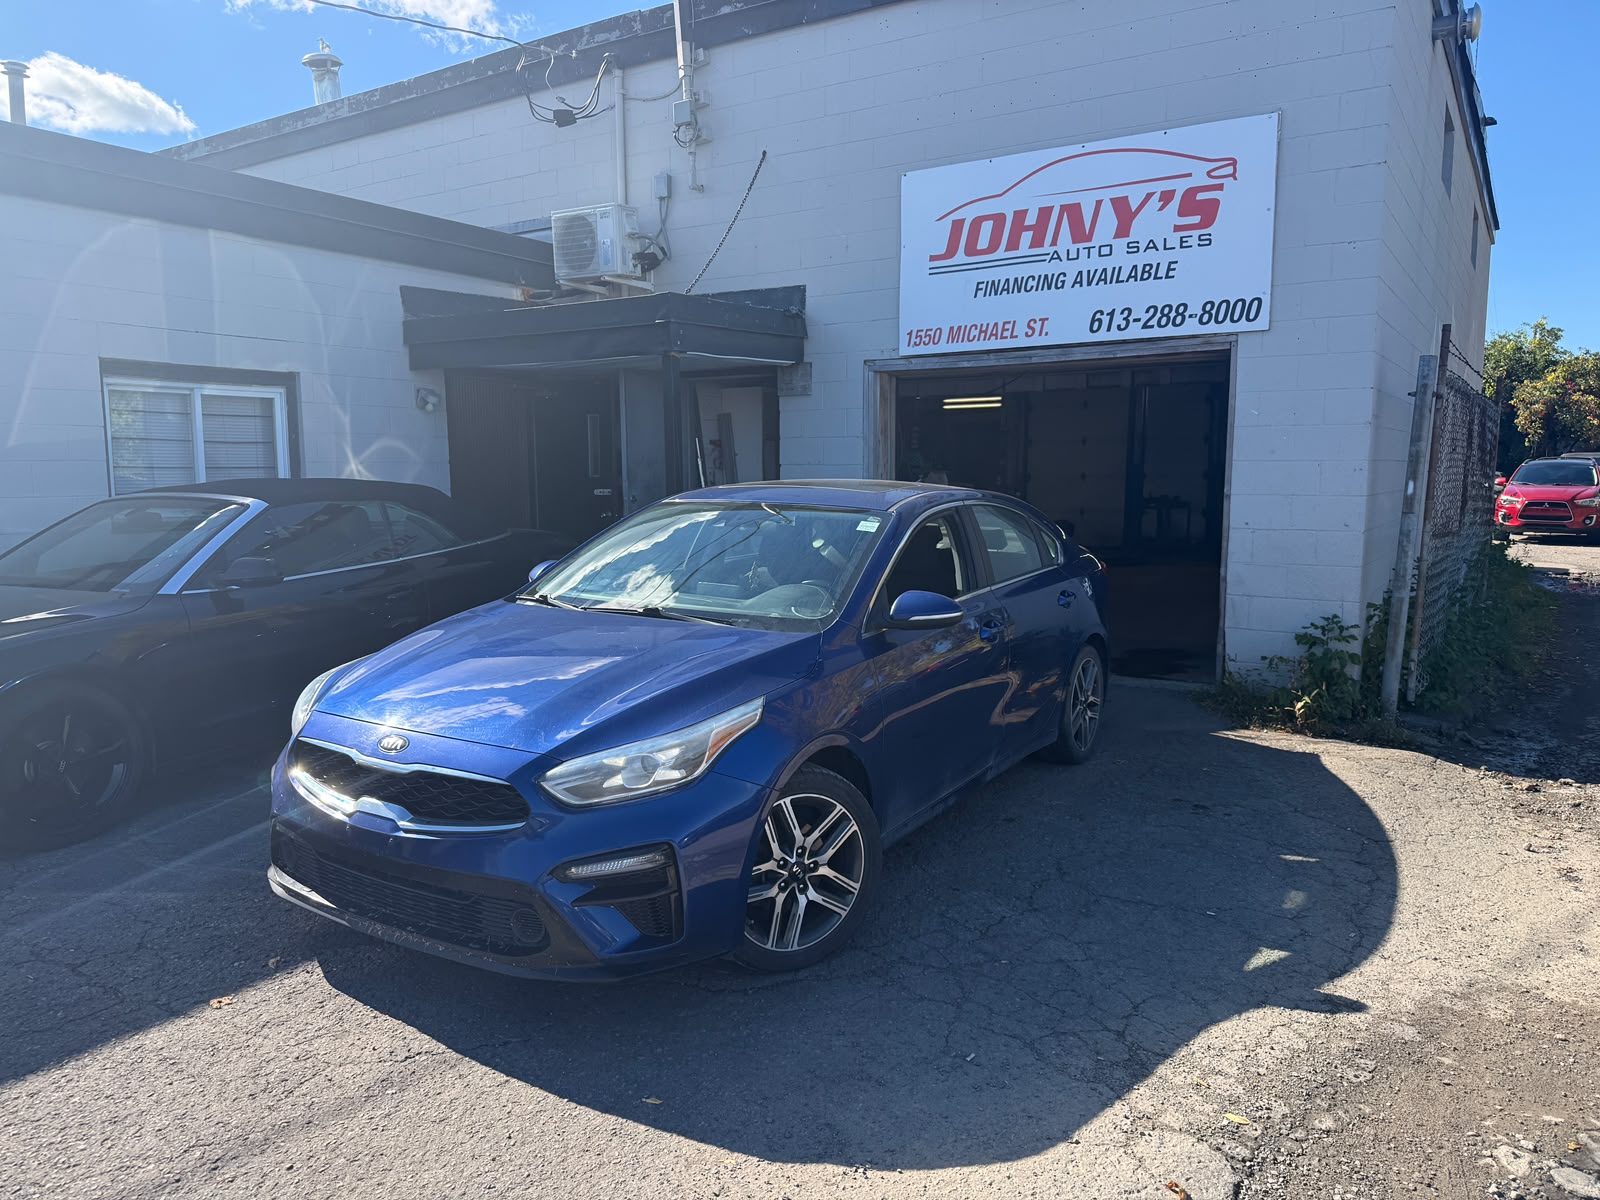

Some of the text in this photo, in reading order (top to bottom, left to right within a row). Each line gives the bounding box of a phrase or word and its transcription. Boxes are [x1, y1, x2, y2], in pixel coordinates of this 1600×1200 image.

[929, 182, 1225, 263] JOHNY'S
[1047, 232, 1213, 264] AUTO SALES
[974, 261, 1179, 298] FINANCING AVAILABLE
[906, 317, 1050, 348] 1550 MICHAEL ST.
[1088, 297, 1263, 334] 613-288-8000
